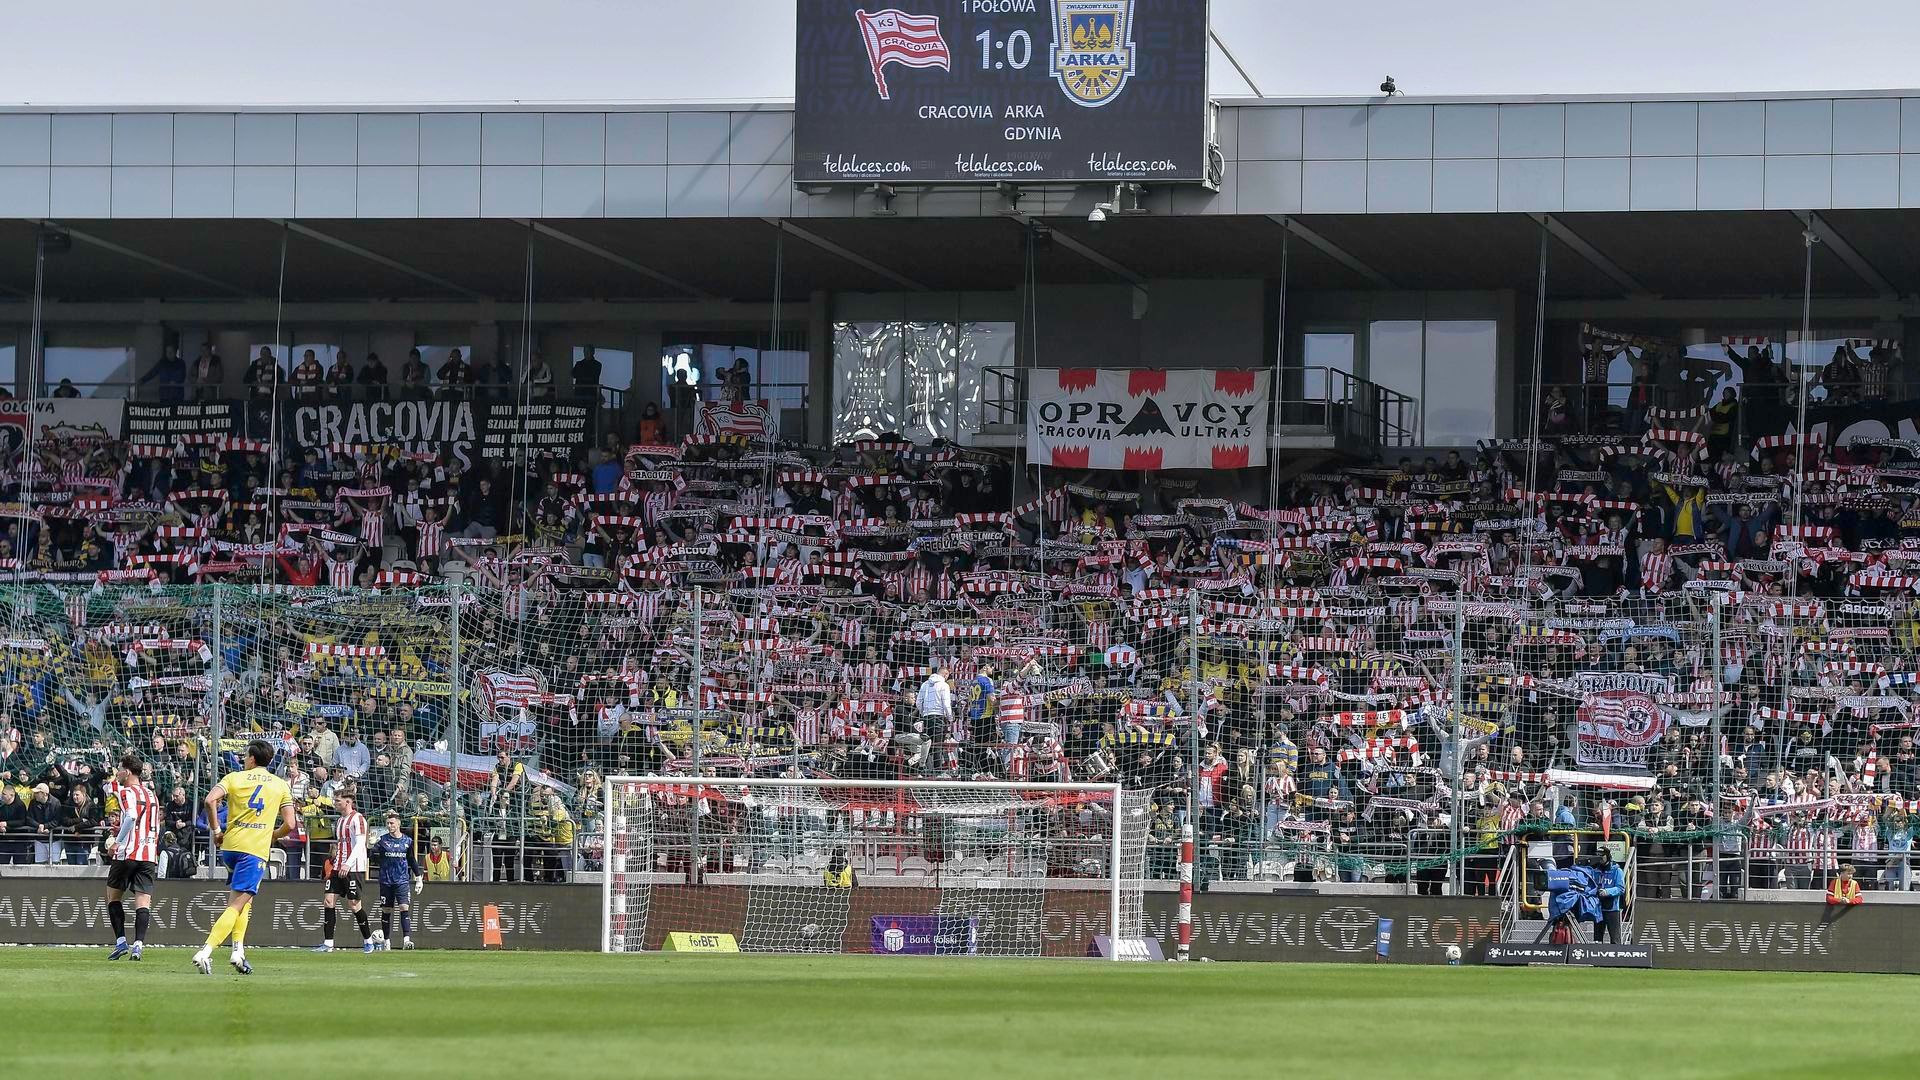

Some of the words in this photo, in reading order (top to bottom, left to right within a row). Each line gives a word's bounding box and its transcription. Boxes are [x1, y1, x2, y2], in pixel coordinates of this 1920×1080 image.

[878, 19, 894, 27] KS
[884, 38, 938, 50] CRACOVIA
[975, 29, 1032, 70] 1:0
[1066, 54, 1119, 66] ARKA
[918, 105, 993, 119] CRACOVIA
[1004, 105, 1045, 118] ARKA
[1004, 127, 1062, 140] GDYNIA
[823, 154, 911, 174] telakces.com
[955, 153, 1043, 173] telakces.com
[1088, 152, 1176, 172] telakces.com
[491, 405, 513, 415] MATI
[295, 402, 476, 446] CRACOVIA
[537, 433, 565, 443] TOMEK
[1036, 424, 1111, 440] CRACOVIA
[1181, 425, 1251, 438] ULTRAS
[629, 470, 674, 480] CRACOVIA
[321, 531, 358, 543] CRACOVIA
[247, 773, 273, 782] ZATOR
[248, 785, 264, 812] 4
[689, 935, 720, 948] forBET
[909, 934, 930, 944] Bank
[1507, 949, 1531, 957] LIVE
[1534, 949, 1562, 957] PARK
[1591, 950, 1616, 958] LIVE
